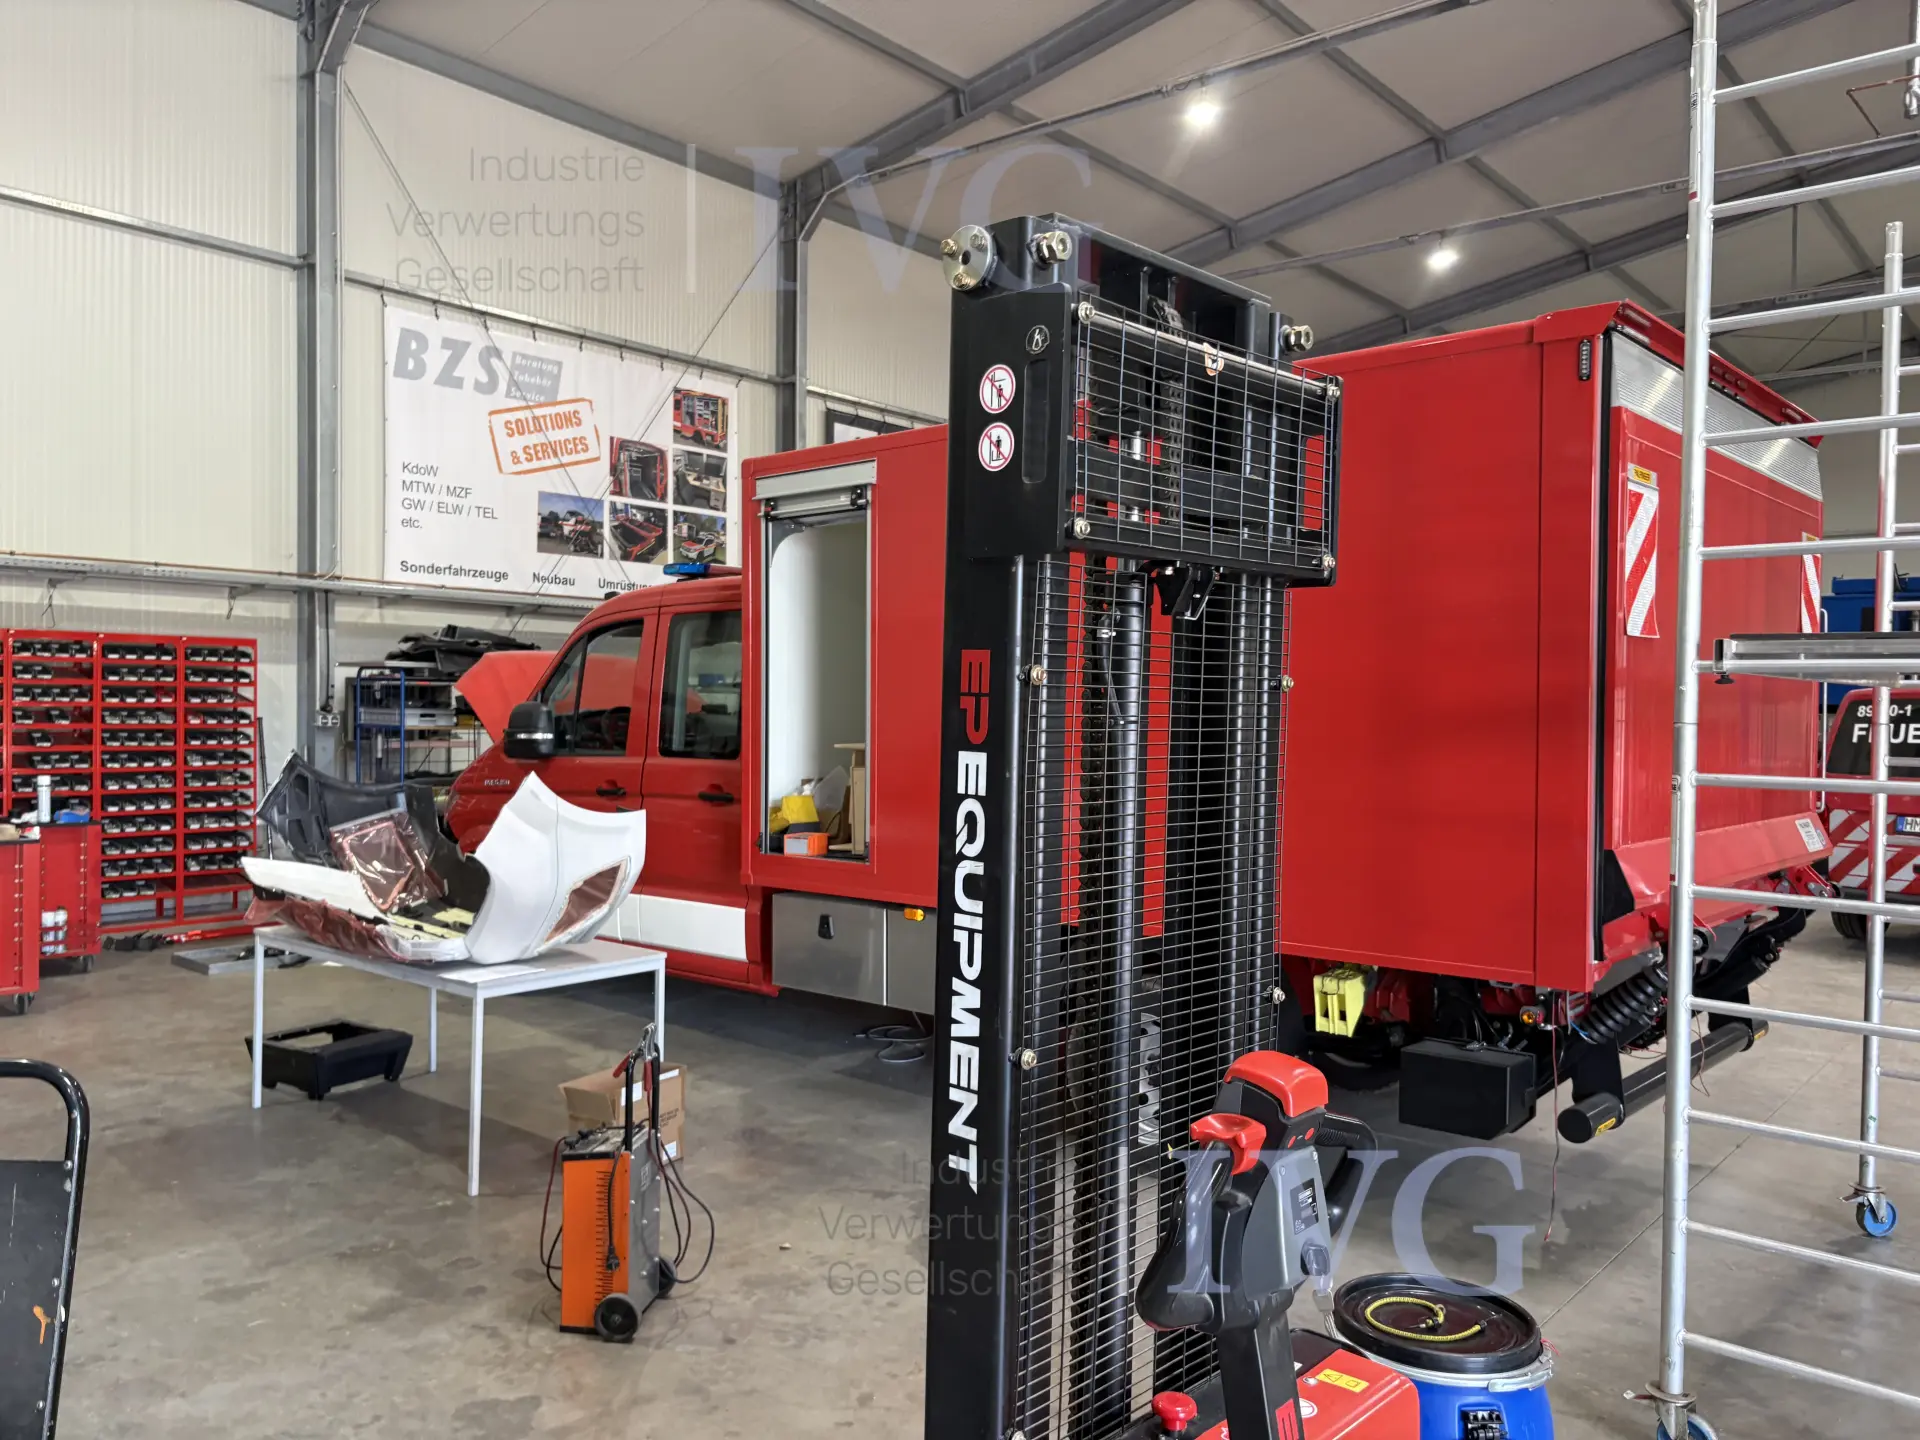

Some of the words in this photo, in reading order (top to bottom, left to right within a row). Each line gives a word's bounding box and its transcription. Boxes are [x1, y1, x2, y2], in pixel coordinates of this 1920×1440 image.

[393, 327, 503, 395] BZS
[504, 410, 583, 438] SOLUTIONS
[510, 450, 523, 465] &
[522, 436, 590, 463] SERVICES
[402, 461, 439, 477] KdoW
[401, 479, 435, 495] MTW
[438, 484, 443, 496] /
[446, 485, 473, 499] MZF
[401, 497, 426, 512] GW
[429, 501, 434, 512] /
[437, 501, 464, 516] ELW
[467, 505, 472, 517] /
[474, 506, 499, 520] TEL
[401, 516, 423, 529] etc.
[400, 560, 509, 583] Sonderfahrzeuge
[532, 572, 576, 586] Neubau
[960, 649, 991, 744] EP
[1856, 704, 1912, 717] 890-1
[1851, 723, 1920, 744] FUE
[948, 750, 988, 1195] EQUIPMENT
